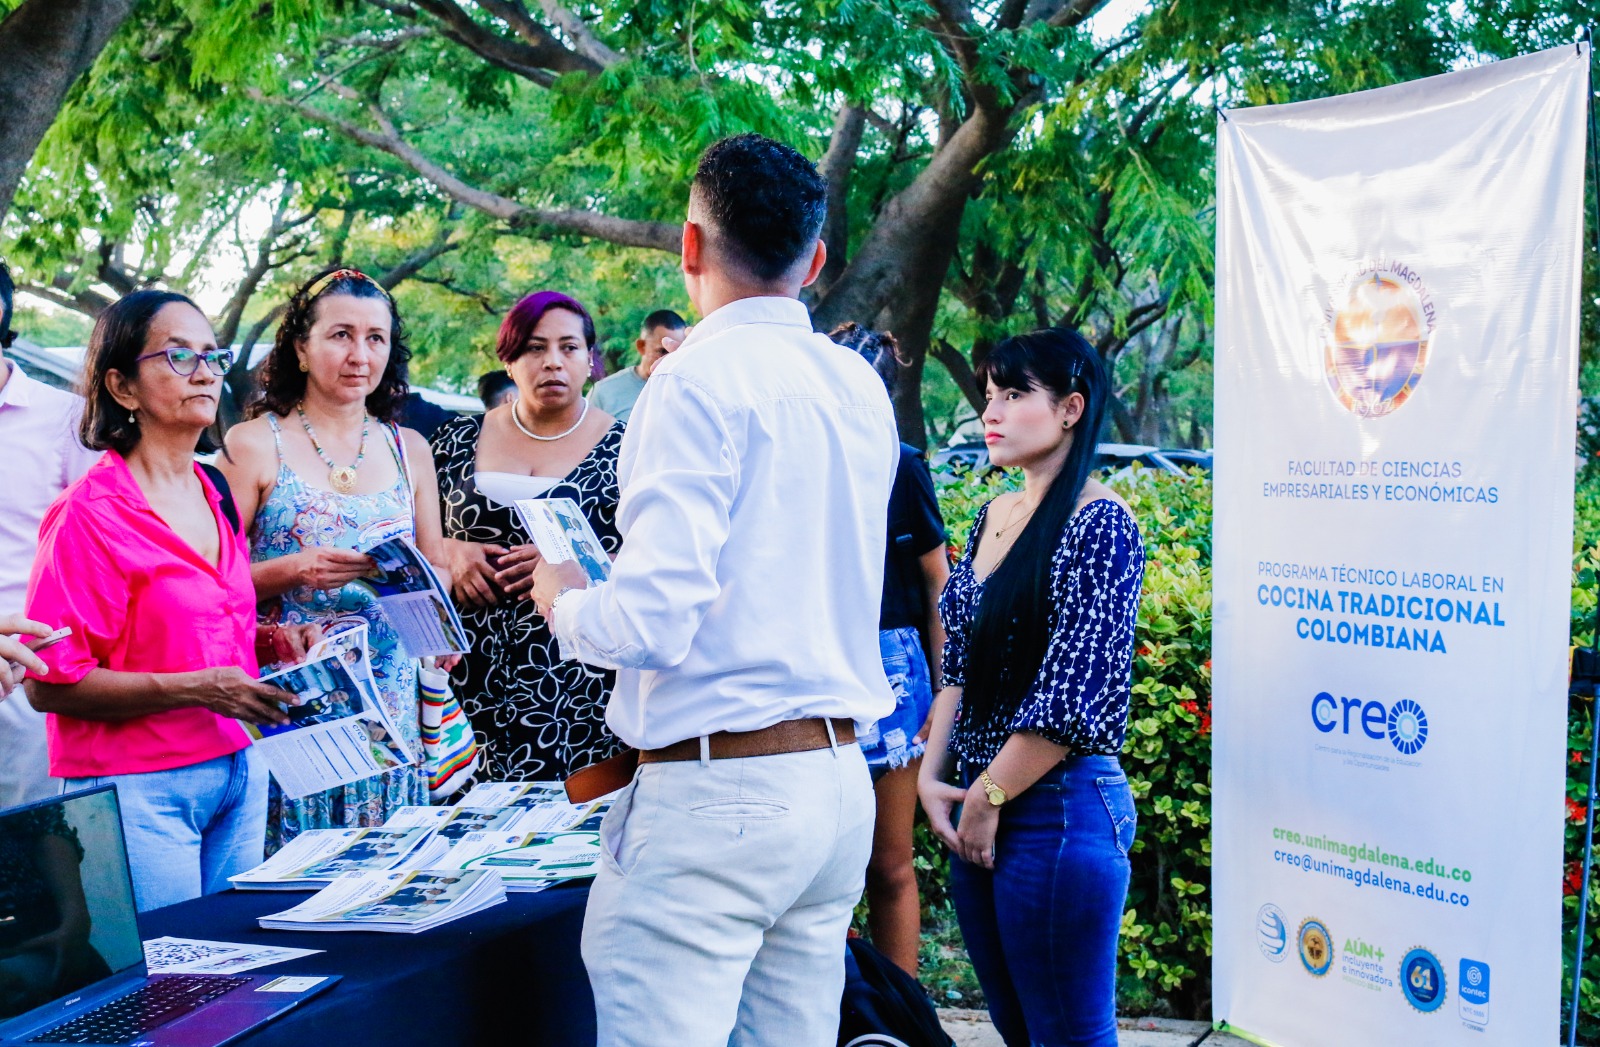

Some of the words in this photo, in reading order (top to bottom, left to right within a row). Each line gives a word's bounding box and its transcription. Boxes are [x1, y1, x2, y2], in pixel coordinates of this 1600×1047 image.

[1369, 258, 1388, 273] DEL
[1390, 260, 1437, 334] MAGDALENA
[1288, 461, 1356, 476] FACULTAD
[1360, 461, 1378, 477] DE
[1382, 461, 1462, 478] CIENCIAS
[1263, 482, 1369, 500] EMPRESARIALES
[1372, 485, 1382, 500] Y
[1385, 482, 1499, 503] ECONÓMICAS
[1258, 561, 1328, 581] PROGRAMA
[1331, 564, 1397, 586] TÉCNICO
[1402, 571, 1477, 592] LABORAL
[1483, 576, 1504, 593] EN
[1257, 584, 1334, 612] COCINA
[1338, 590, 1505, 627] TRADICIONAL
[1296, 617, 1447, 654] COLOMBIANA
[1311, 691, 1428, 755] creo
[1272, 826, 1472, 883] creo.unimagdalena.edu.co
[1274, 848, 1470, 907] creo@unimagdalena.edu.co
[1342, 954, 1384, 974] incluyente
[1348, 966, 1393, 987] innovadora
[1410, 965, 1433, 991] 61
[1461, 985, 1486, 999] icontec
